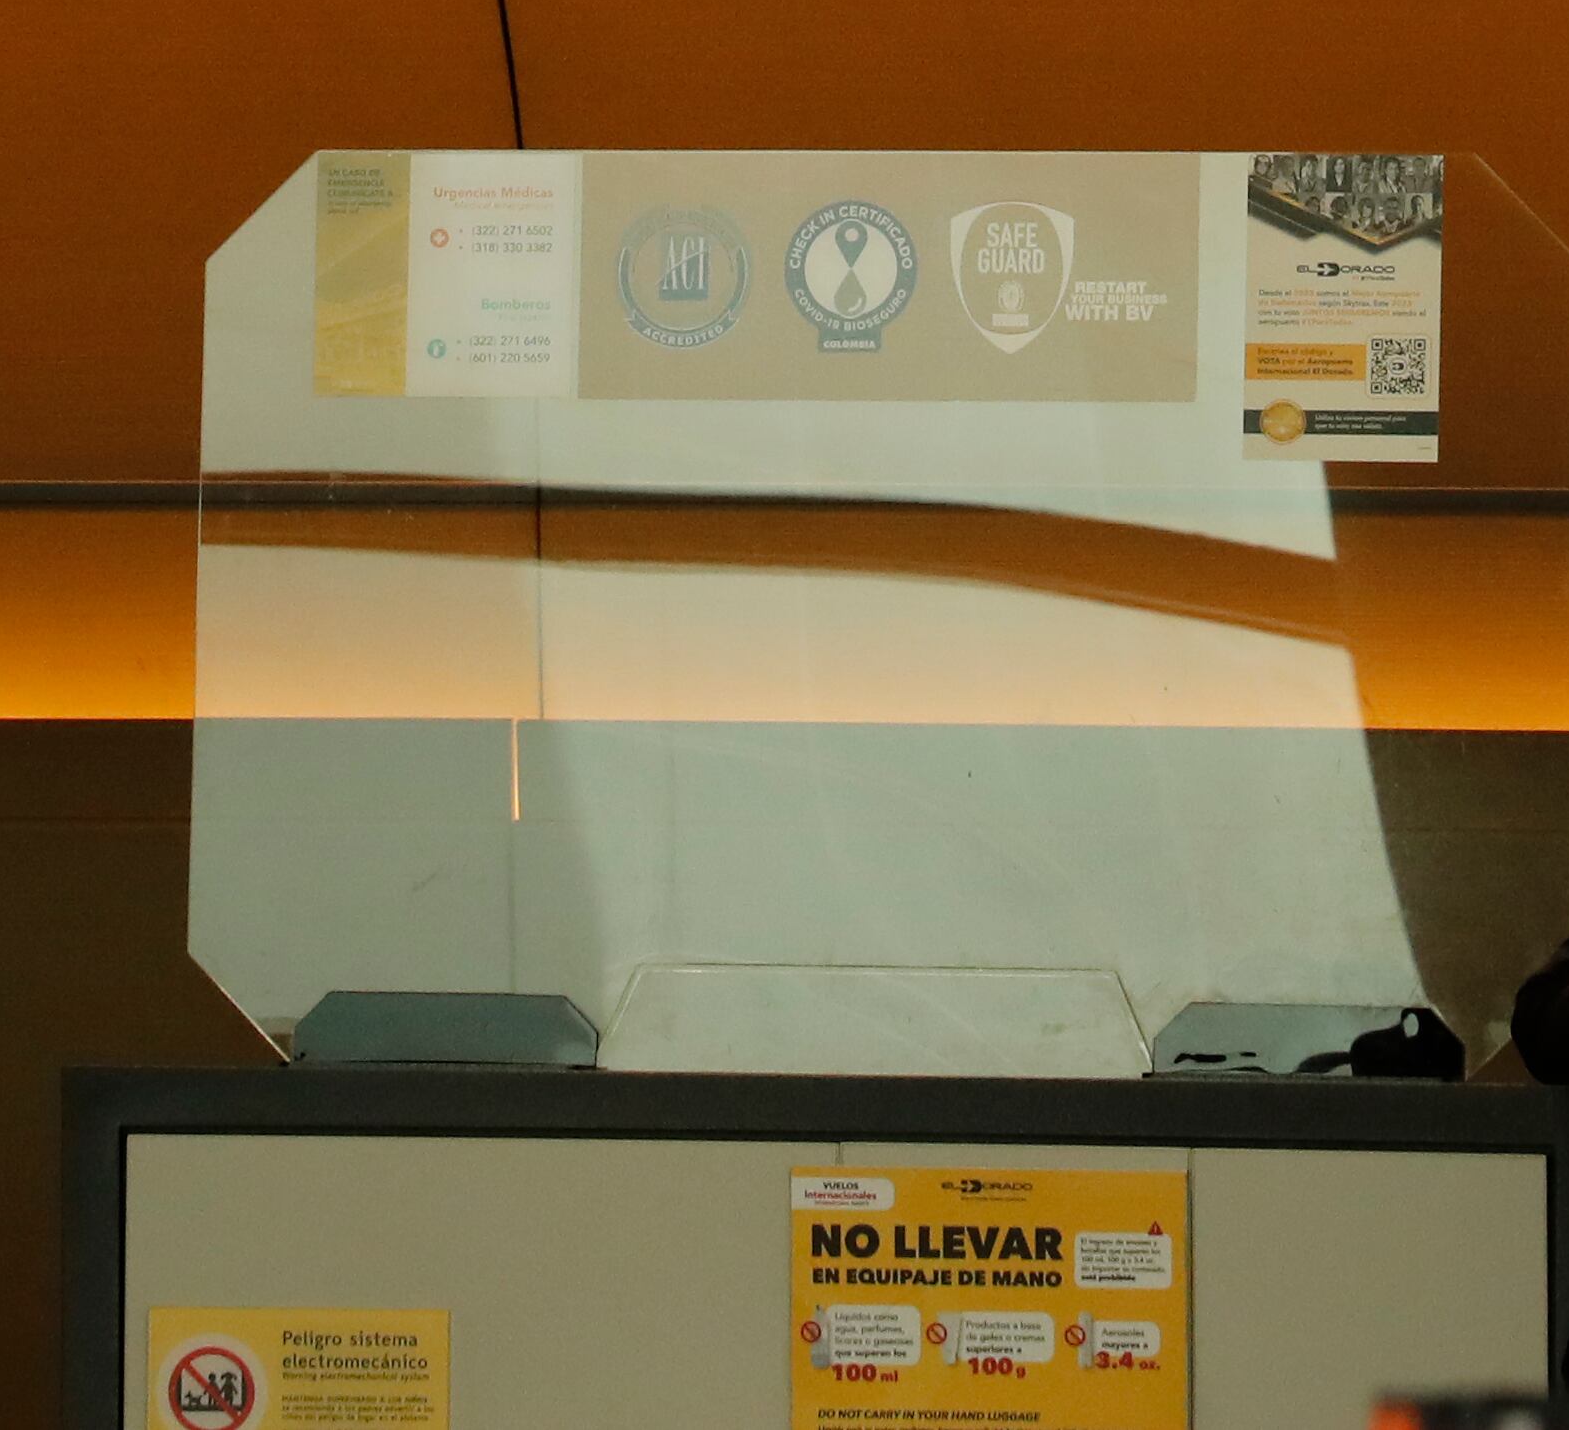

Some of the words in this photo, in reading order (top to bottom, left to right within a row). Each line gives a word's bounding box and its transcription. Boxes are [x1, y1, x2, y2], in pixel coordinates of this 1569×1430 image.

[434, 186, 496, 201] Urgencias
[501, 185, 553, 198] Médicas
[472, 225, 499, 237] (322)
[503, 226, 523, 236] 271
[526, 226, 553, 236] 6502
[790, 220, 819, 268] CHECK
[819, 209, 835, 225] IN
[839, 206, 913, 269] CERTIFICADO
[986, 222, 1039, 248] SAFE
[503, 243, 523, 253] 330
[662, 235, 705, 291] ACI
[978, 249, 1045, 274] GUARD
[1074, 281, 1147, 294] RESTART
[481, 298, 551, 311] Bomberos
[1071, 294, 1105, 304] YOUR
[1107, 294, 1168, 305] BUSINESS
[843, 289, 906, 331] BIOSEGURO
[1065, 305, 1119, 321] WITH
[1125, 305, 1156, 321] BV
[469, 335, 496, 347] (322)
[500, 336, 520, 346] 271
[523, 336, 551, 346] 6496
[643, 325, 723, 346] ACCREDITED
[823, 340, 876, 349] COLOMBIA
[469, 352, 496, 363] (601)
[500, 353, 520, 363] 220
[523, 353, 550, 363] 5659
[822, 1181, 859, 1190] VUELOS
[804, 1189, 877, 1200] Internacionales
[811, 1223, 880, 1258] NO
[894, 1225, 1063, 1260] LLEVAR
[812, 1268, 840, 1285] EN
[847, 1269, 952, 1286] EQUIPAJE
[959, 1270, 986, 1286] DE
[992, 1271, 1063, 1287] MANO
[966, 1320, 1010, 1330] Productos
[1102, 1327, 1144, 1337] Aerosoles
[282, 1330, 342, 1351] Peligro
[350, 1330, 418, 1347] sistema
[282, 1353, 428, 1370] electromecánico
[835, 1350, 851, 1358] que
[1096, 1351, 1134, 1369] 3.4
[831, 1363, 877, 1381] 100
[880, 1370, 898, 1382] ml
[968, 1357, 1013, 1374] 100
[1016, 1366, 1026, 1378] g
[817, 1409, 836, 1419] DO
[838, 1410, 862, 1419] NOT
[864, 1410, 901, 1420] CARRY
[902, 1410, 915, 1420] IN
[917, 1411, 950, 1420] YOUR
[952, 1411, 984, 1421] HAND
[986, 1411, 1041, 1422] LUGGAGE
